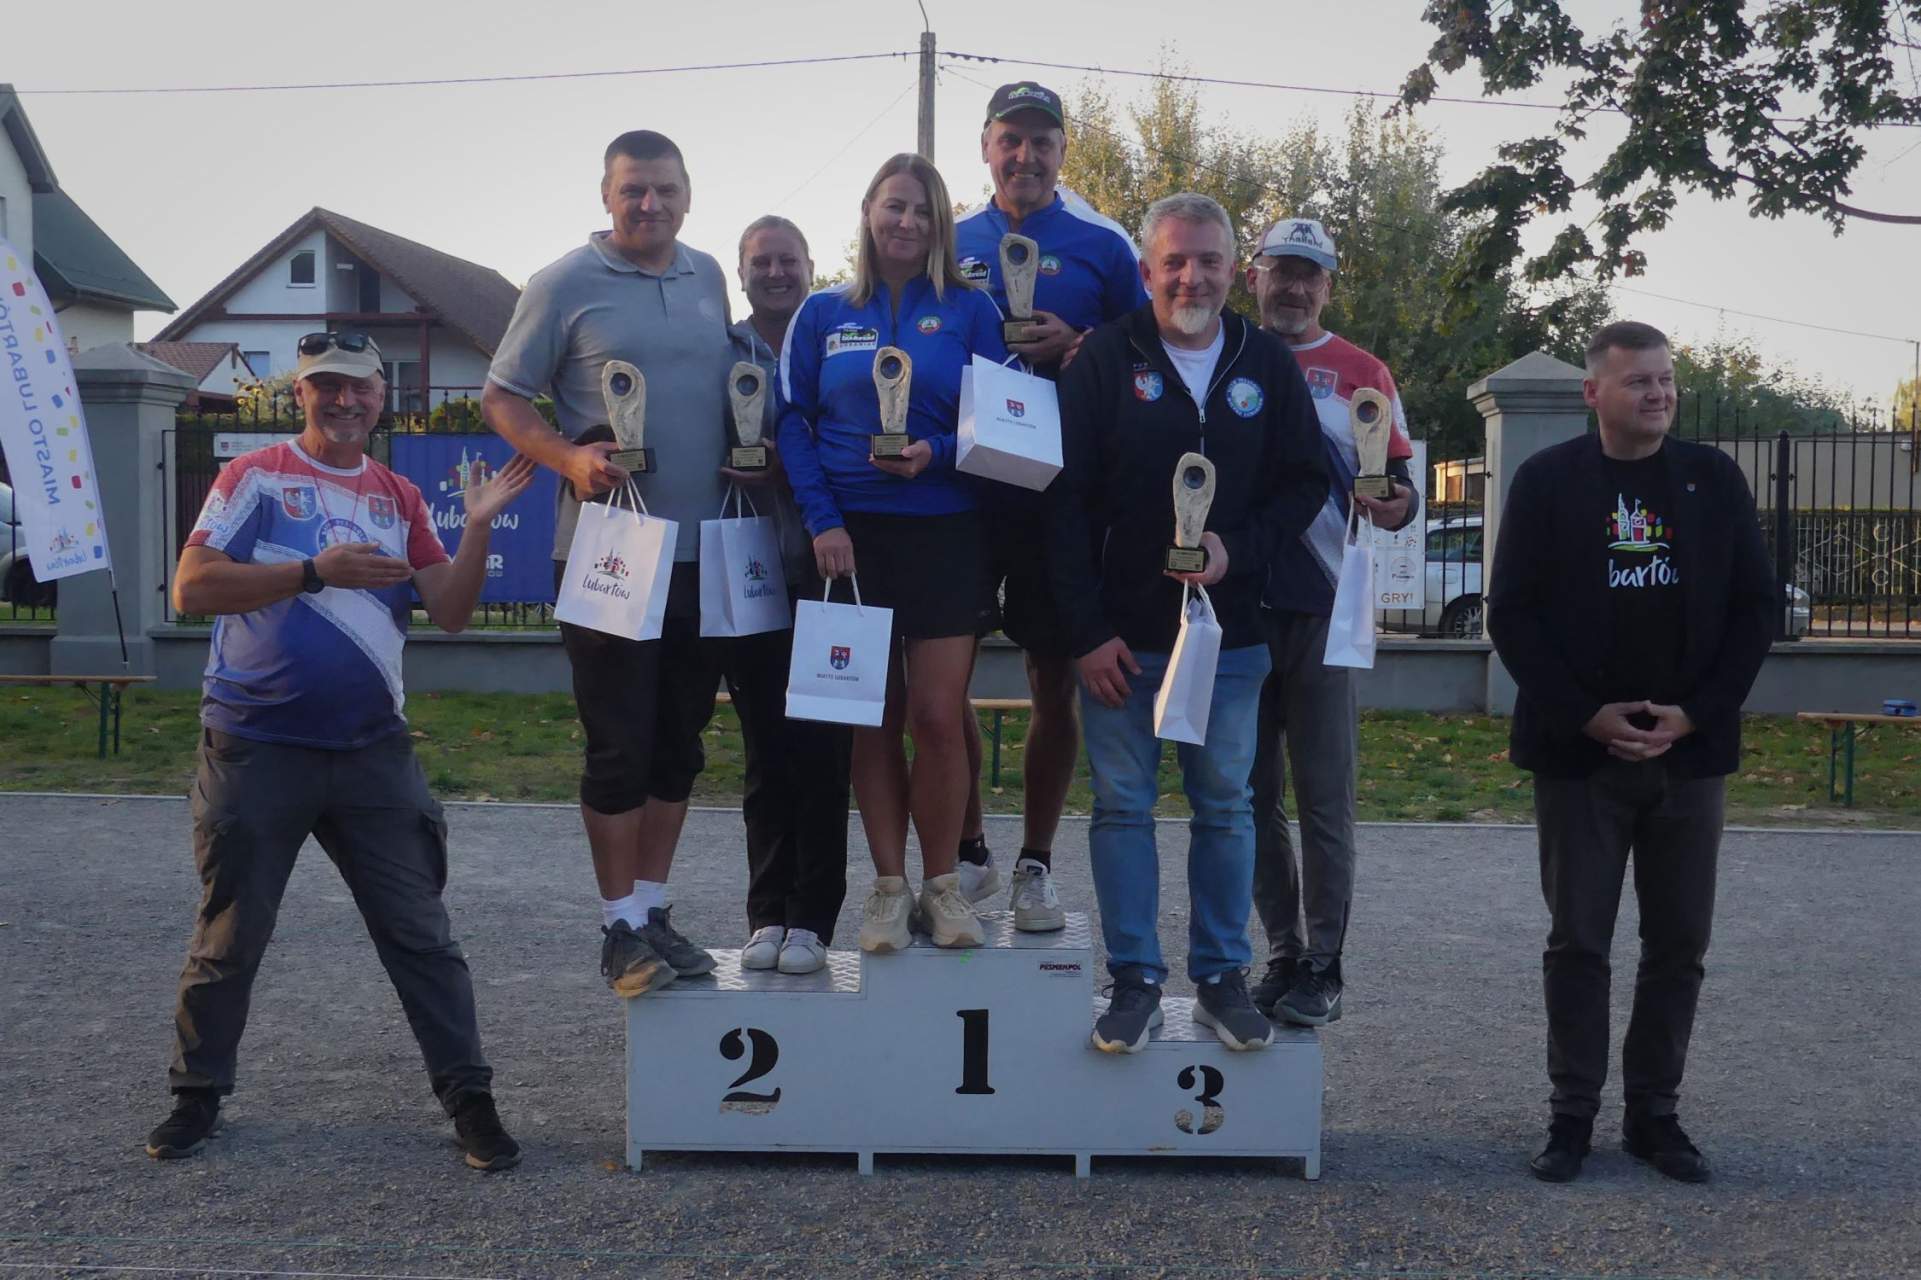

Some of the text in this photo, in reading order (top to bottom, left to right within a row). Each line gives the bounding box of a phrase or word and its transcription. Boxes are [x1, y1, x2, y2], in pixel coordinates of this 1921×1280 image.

[1381, 592, 1414, 604] GRY!
[719, 1027, 781, 1115] 2
[954, 1008, 995, 1095] 1
[1174, 1064, 1225, 1136] 3
